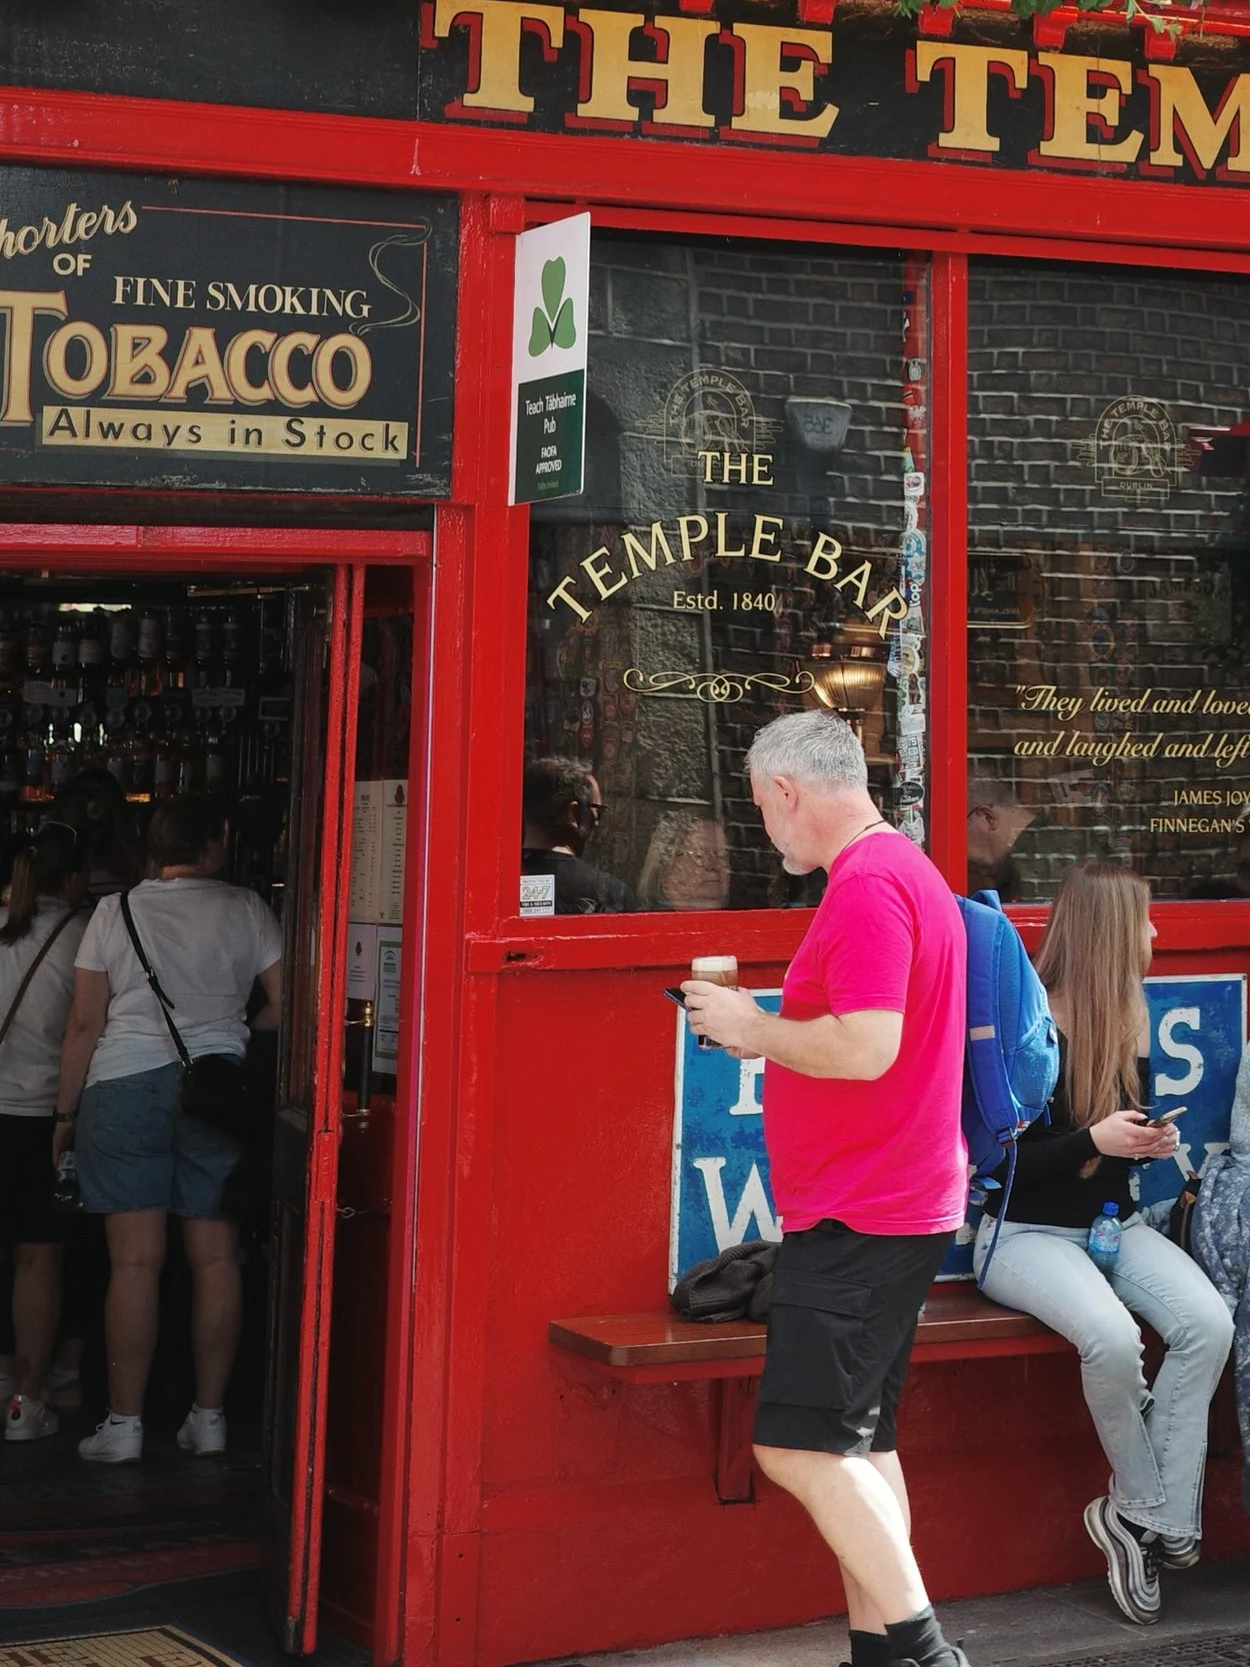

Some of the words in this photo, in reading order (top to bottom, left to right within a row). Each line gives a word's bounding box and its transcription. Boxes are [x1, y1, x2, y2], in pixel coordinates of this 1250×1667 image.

[53, 253, 92, 276] OF
[113, 275, 196, 310] FINE
[206, 281, 371, 319] SMOKING
[0, 290, 372, 426] TOBACCO
[525, 396, 544, 416] Teach
[681, 375, 736, 395] TEMPLE
[734, 394, 751, 428] BAR
[1110, 401, 1161, 420] TEMPLE
[48, 407, 201, 448] Always
[229, 418, 263, 446] in
[281, 416, 400, 453] Stock
[543, 416, 557, 434] Pub
[697, 450, 774, 485] THE
[546, 512, 785, 625] TEMPLE
[803, 531, 910, 641] BAR
[672, 590, 723, 612] Estd.
[731, 591, 776, 613] 1840
[1015, 684, 1084, 722] "They
[1089, 688, 1152, 716] lived
[1152, 689, 1202, 716] and
[1014, 731, 1064, 757] and
[1065, 731, 1162, 767] laughed
[1164, 733, 1215, 759] and
[1173, 790, 1223, 807] JAMES
[1150, 818, 1245, 834] FINNEGAN'S
